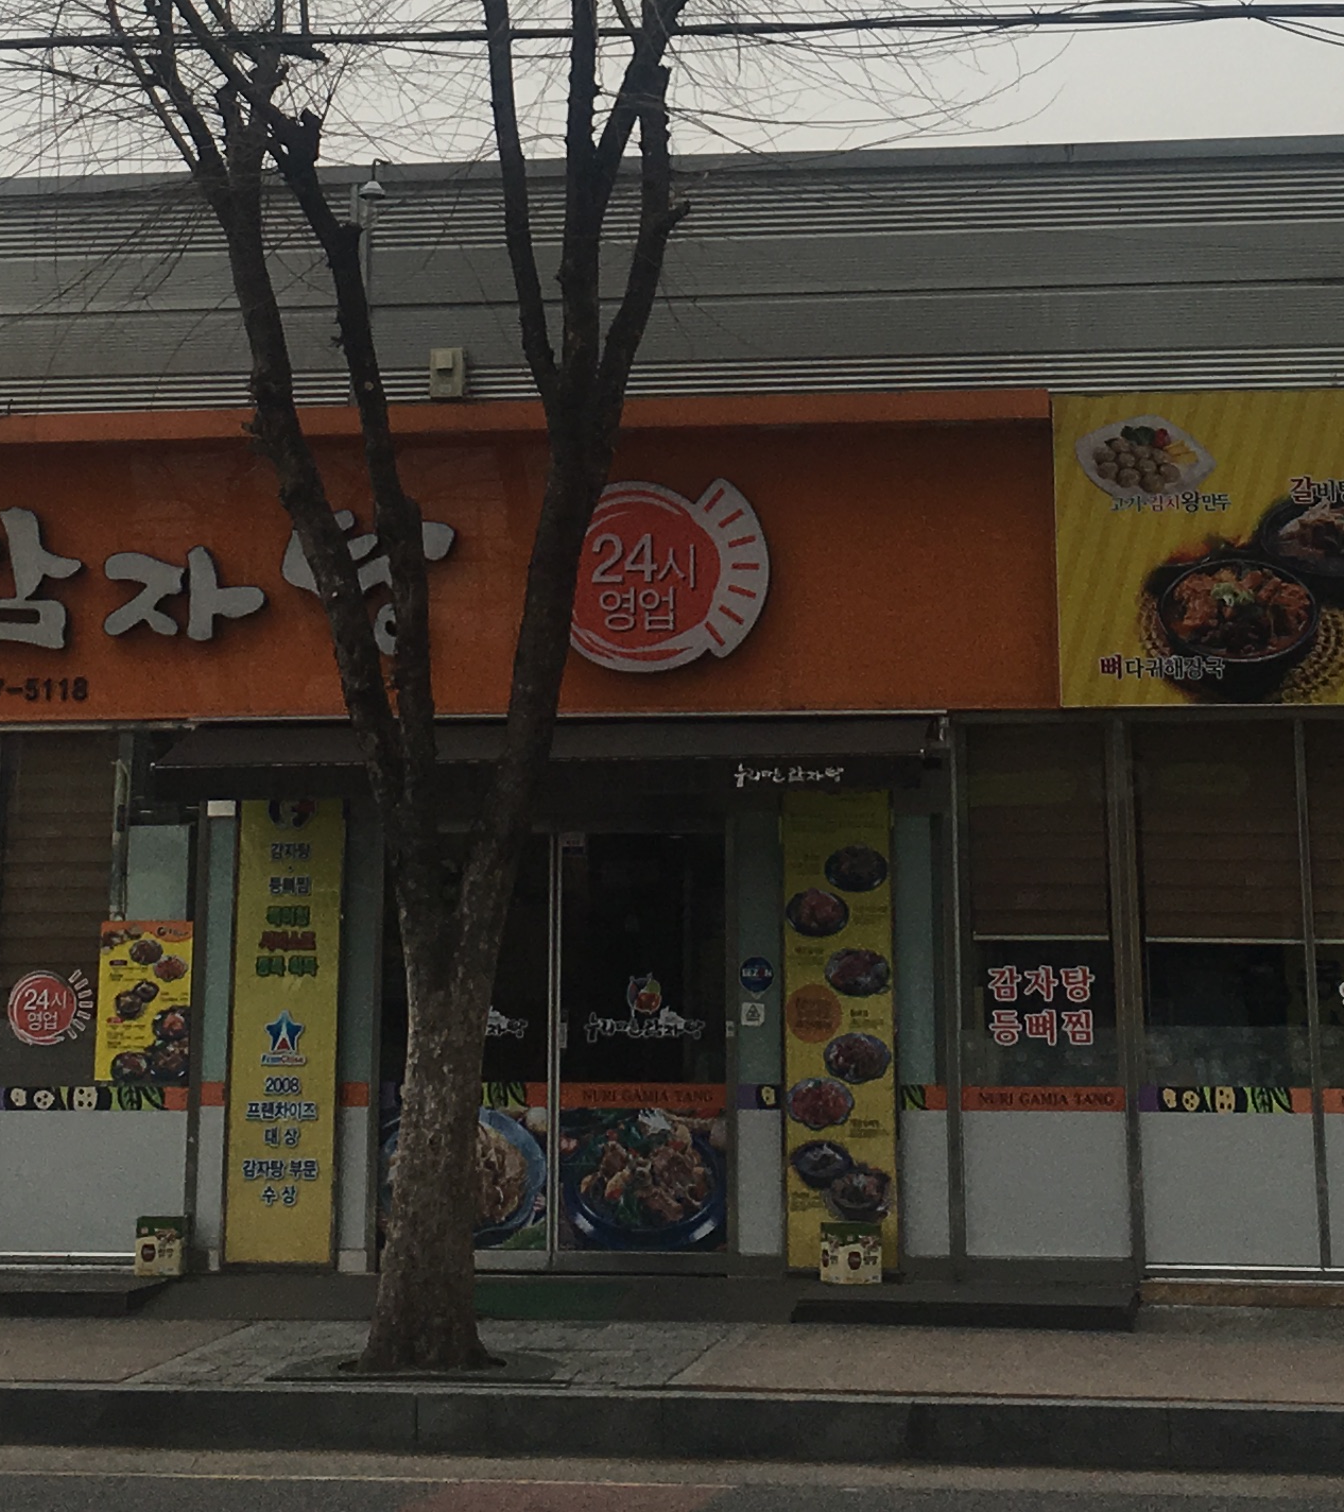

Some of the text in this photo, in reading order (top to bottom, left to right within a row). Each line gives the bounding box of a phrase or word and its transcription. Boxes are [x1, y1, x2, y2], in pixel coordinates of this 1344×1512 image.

[590, 532, 699, 589] 24시
[597, 588, 678, 632] 영업
[1099, 652, 1227, 681] 뼈다귀해장국
[270, 842, 312, 861] 감자탕
[987, 964, 1095, 1004] 감자탕
[22, 988, 68, 1012] 24시
[26, 1011, 59, 1032] 영업
[989, 1009, 1094, 1046] 등뼈찜
[264, 1077, 301, 1093] 2008
[977, 1091, 1016, 1105] NURI
[1073, 1091, 1116, 1105] TANG
[242, 1159, 319, 1179] 감자탕 부문
